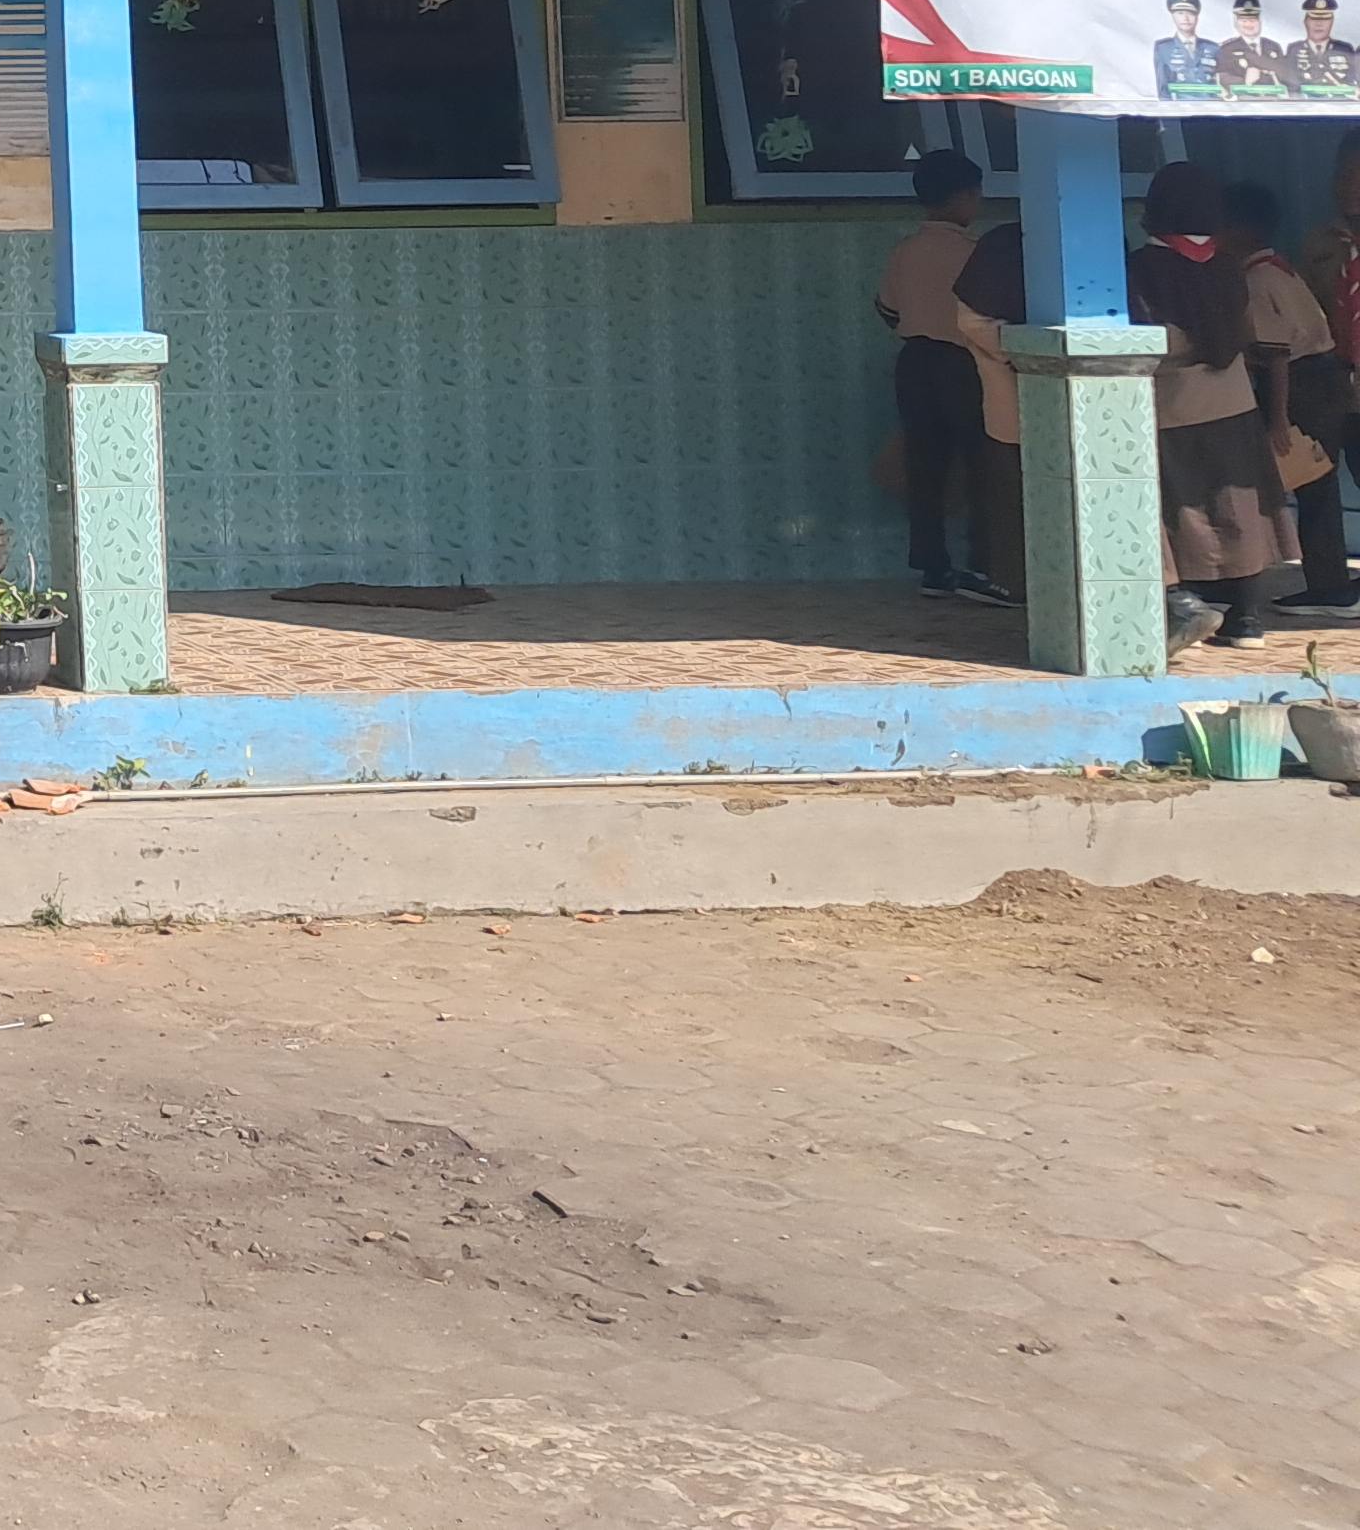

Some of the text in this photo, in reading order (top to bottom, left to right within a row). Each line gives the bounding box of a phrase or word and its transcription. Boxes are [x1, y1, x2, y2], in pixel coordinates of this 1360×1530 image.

[894, 69, 1078, 88] SDN 1 BANGOAN
